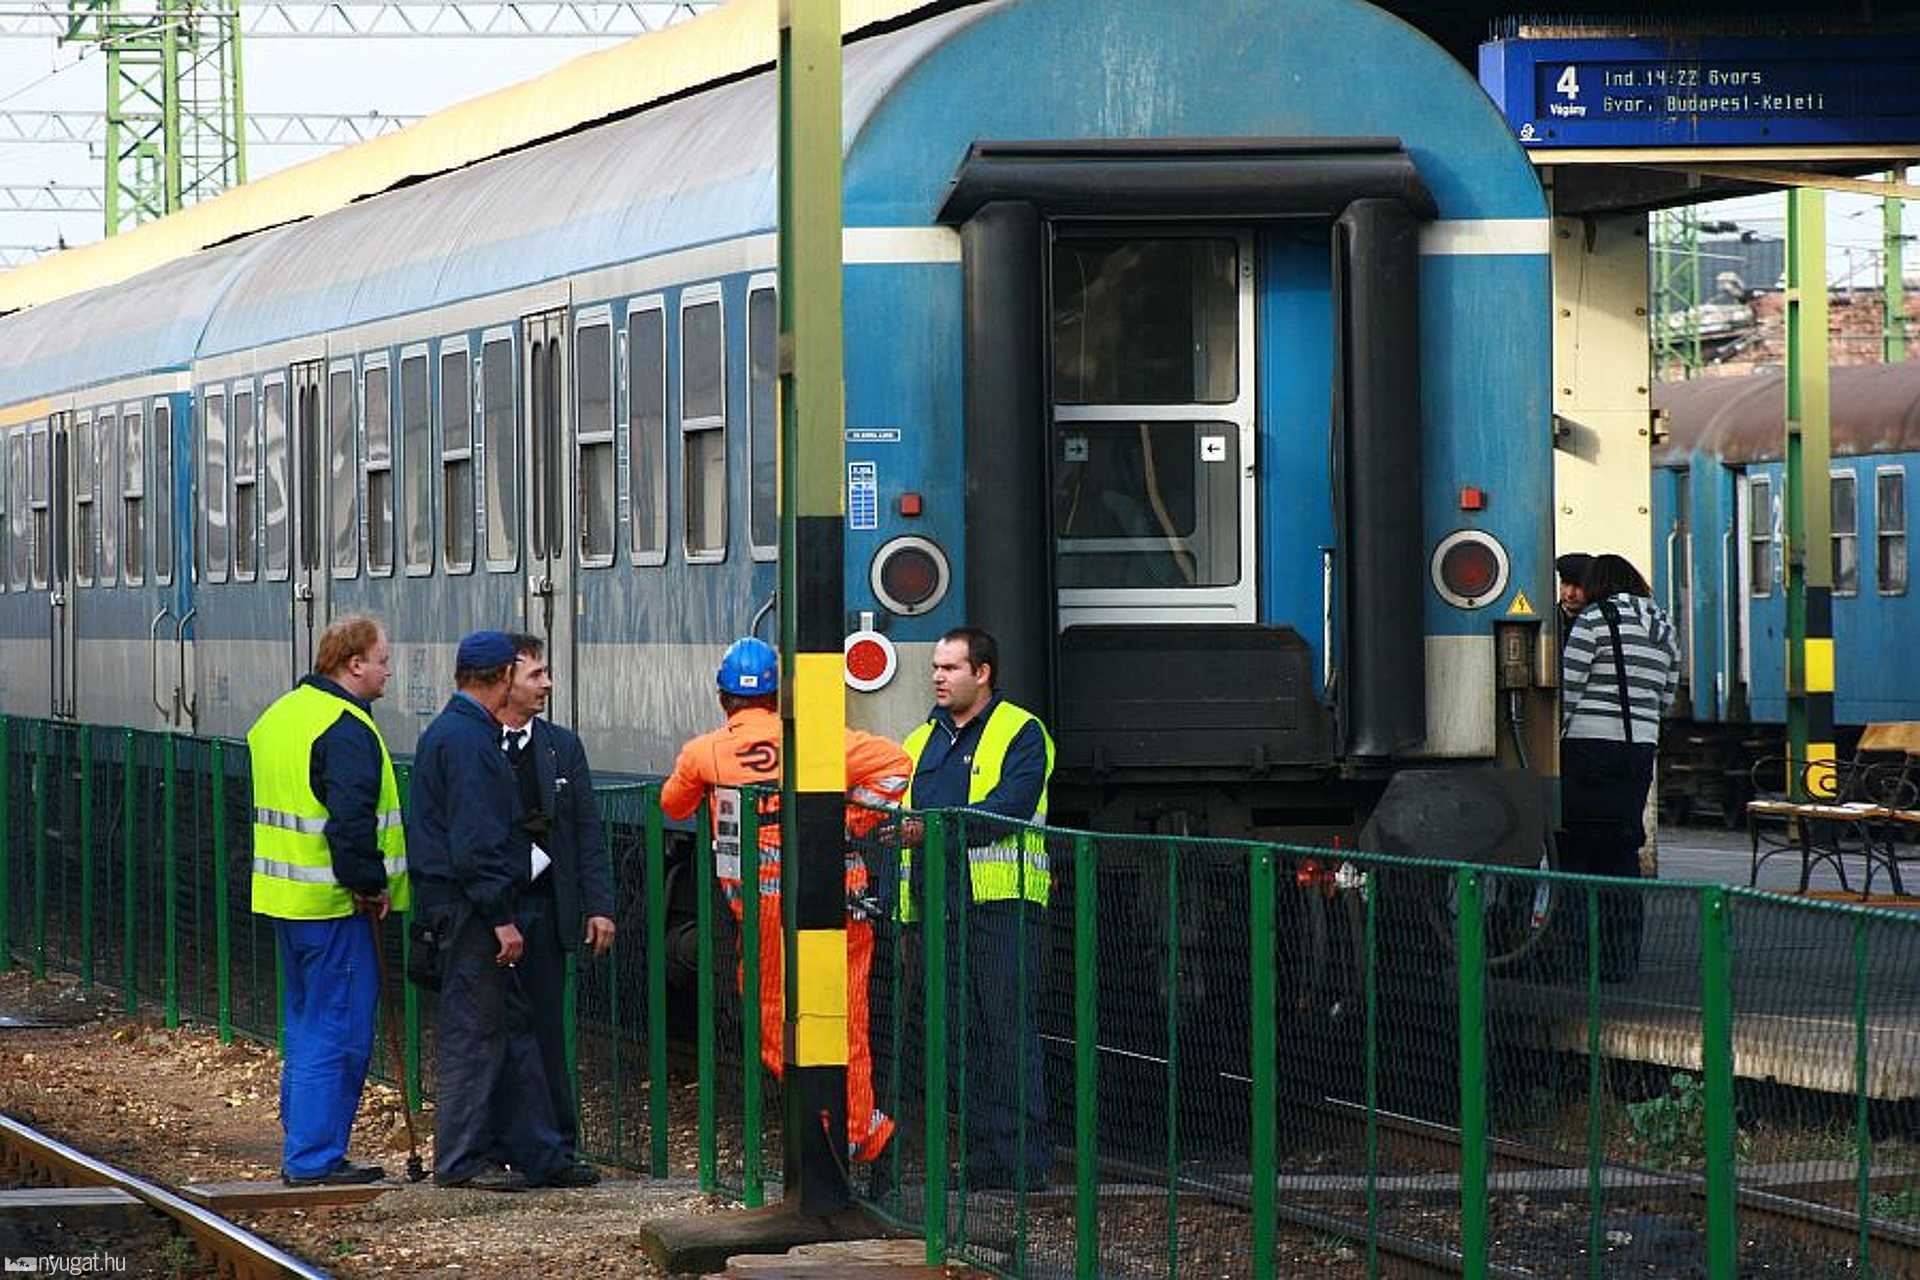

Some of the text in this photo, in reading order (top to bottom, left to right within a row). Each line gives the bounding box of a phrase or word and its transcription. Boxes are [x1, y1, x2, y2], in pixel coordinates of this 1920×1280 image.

[1556, 65, 1580, 100] 4
[1708, 69, 1761, 87] Gyors
[1667, 93, 1824, 112] Budapest-Keleti
